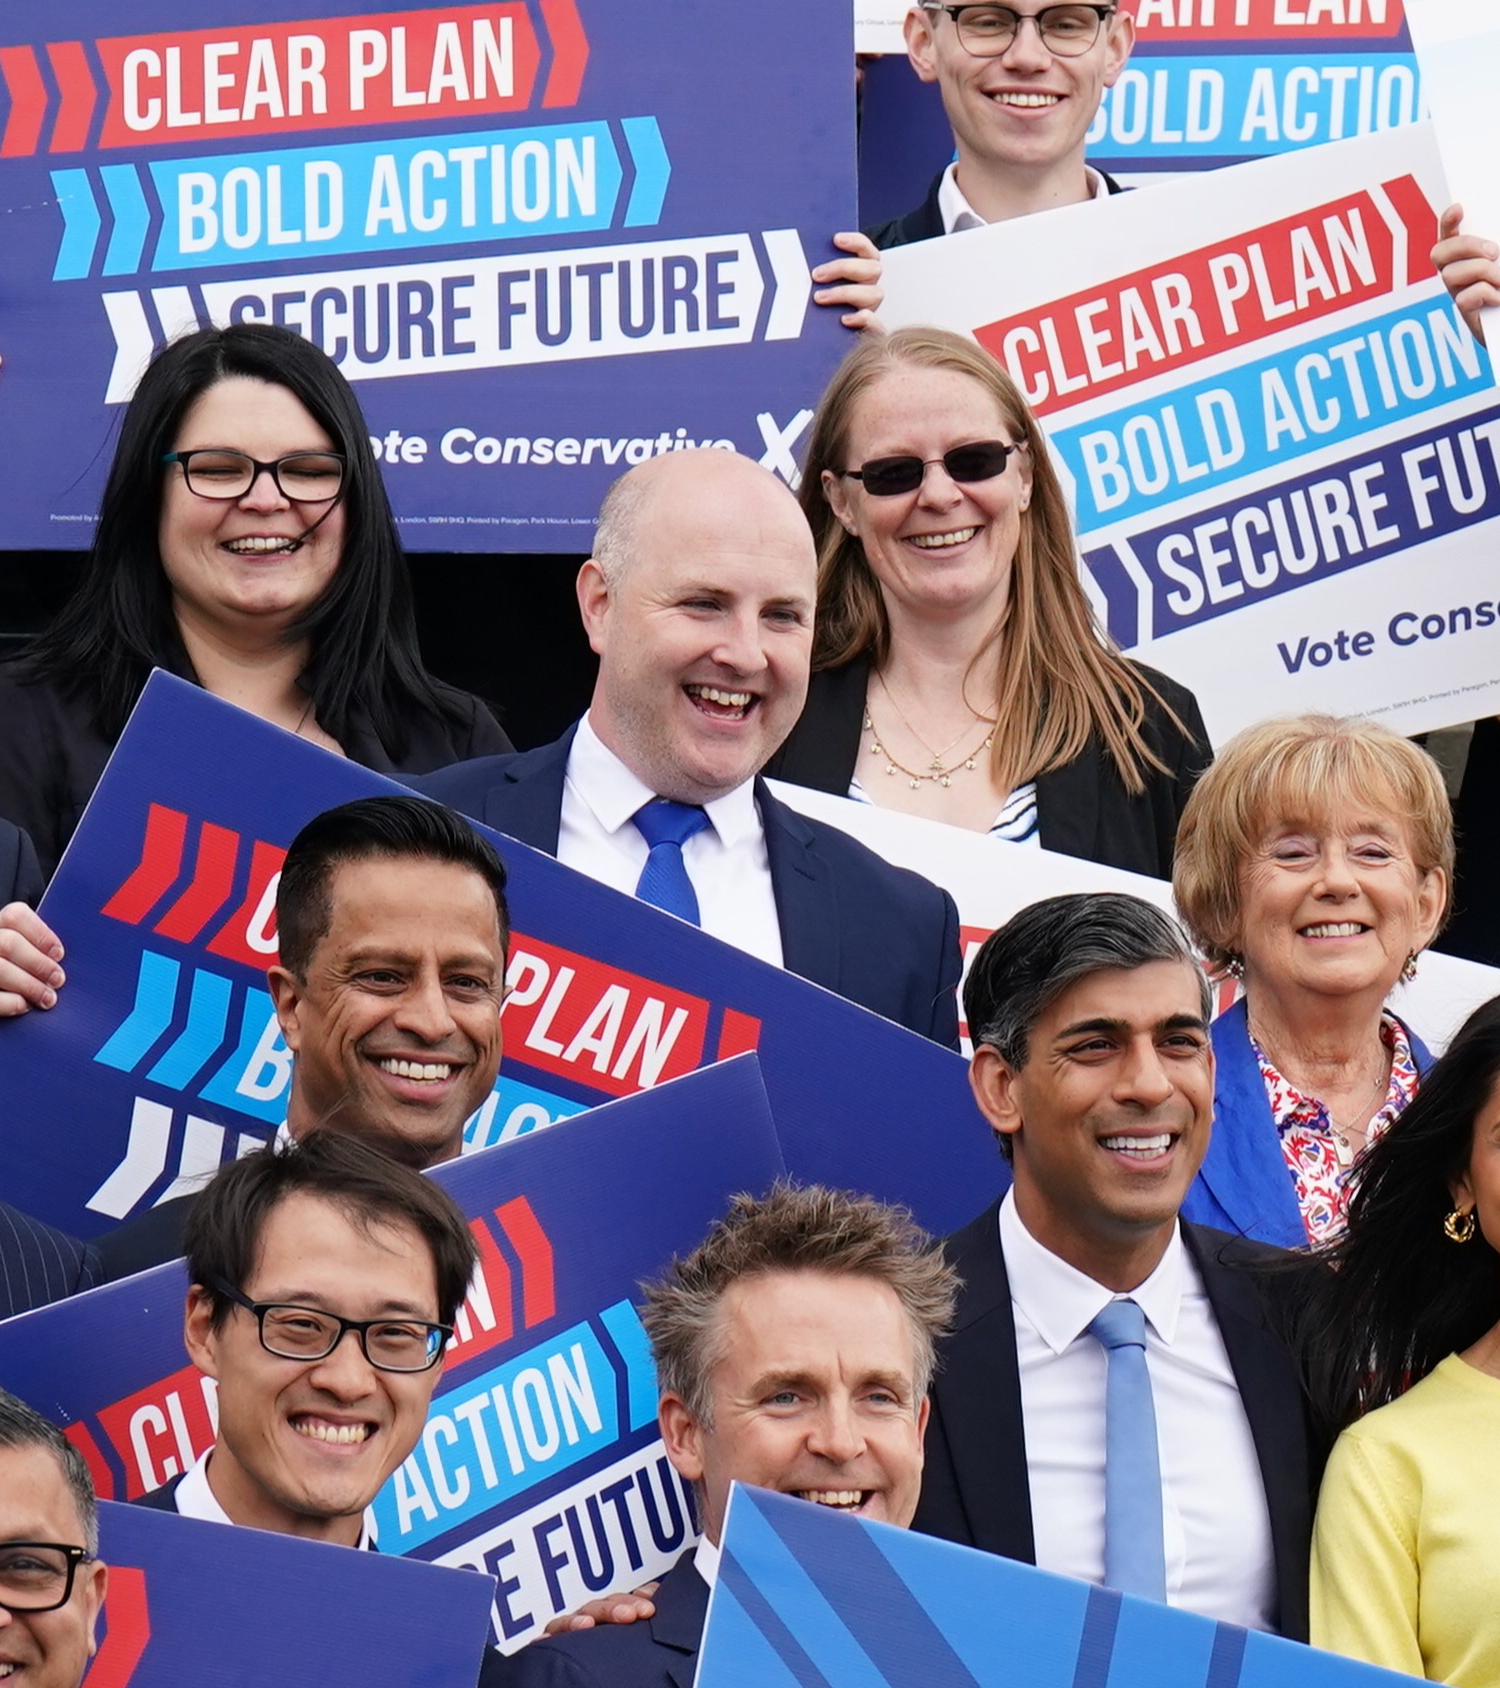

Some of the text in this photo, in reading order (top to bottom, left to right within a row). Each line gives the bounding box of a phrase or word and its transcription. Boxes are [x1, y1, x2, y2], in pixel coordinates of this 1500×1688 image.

[121, 17, 515, 131] CLEAR PLAN
[1240, 66, 1430, 143] ACTIO
[177, 137, 597, 255] BOLD ACTION
[498, 249, 740, 351] FUTURE
[1001, 208, 1377, 406] CLEAR PLAN
[367, 430, 428, 465] ote
[1079, 305, 1482, 513] BOLD ACTION
[1155, 461, 1399, 617] SECURE
[1277, 631, 1375, 675] Vote
[501, 951, 690, 1089] PLAN
[395, 1343, 603, 1536] ACTION
[533, 1457, 701, 1614] FUTU
